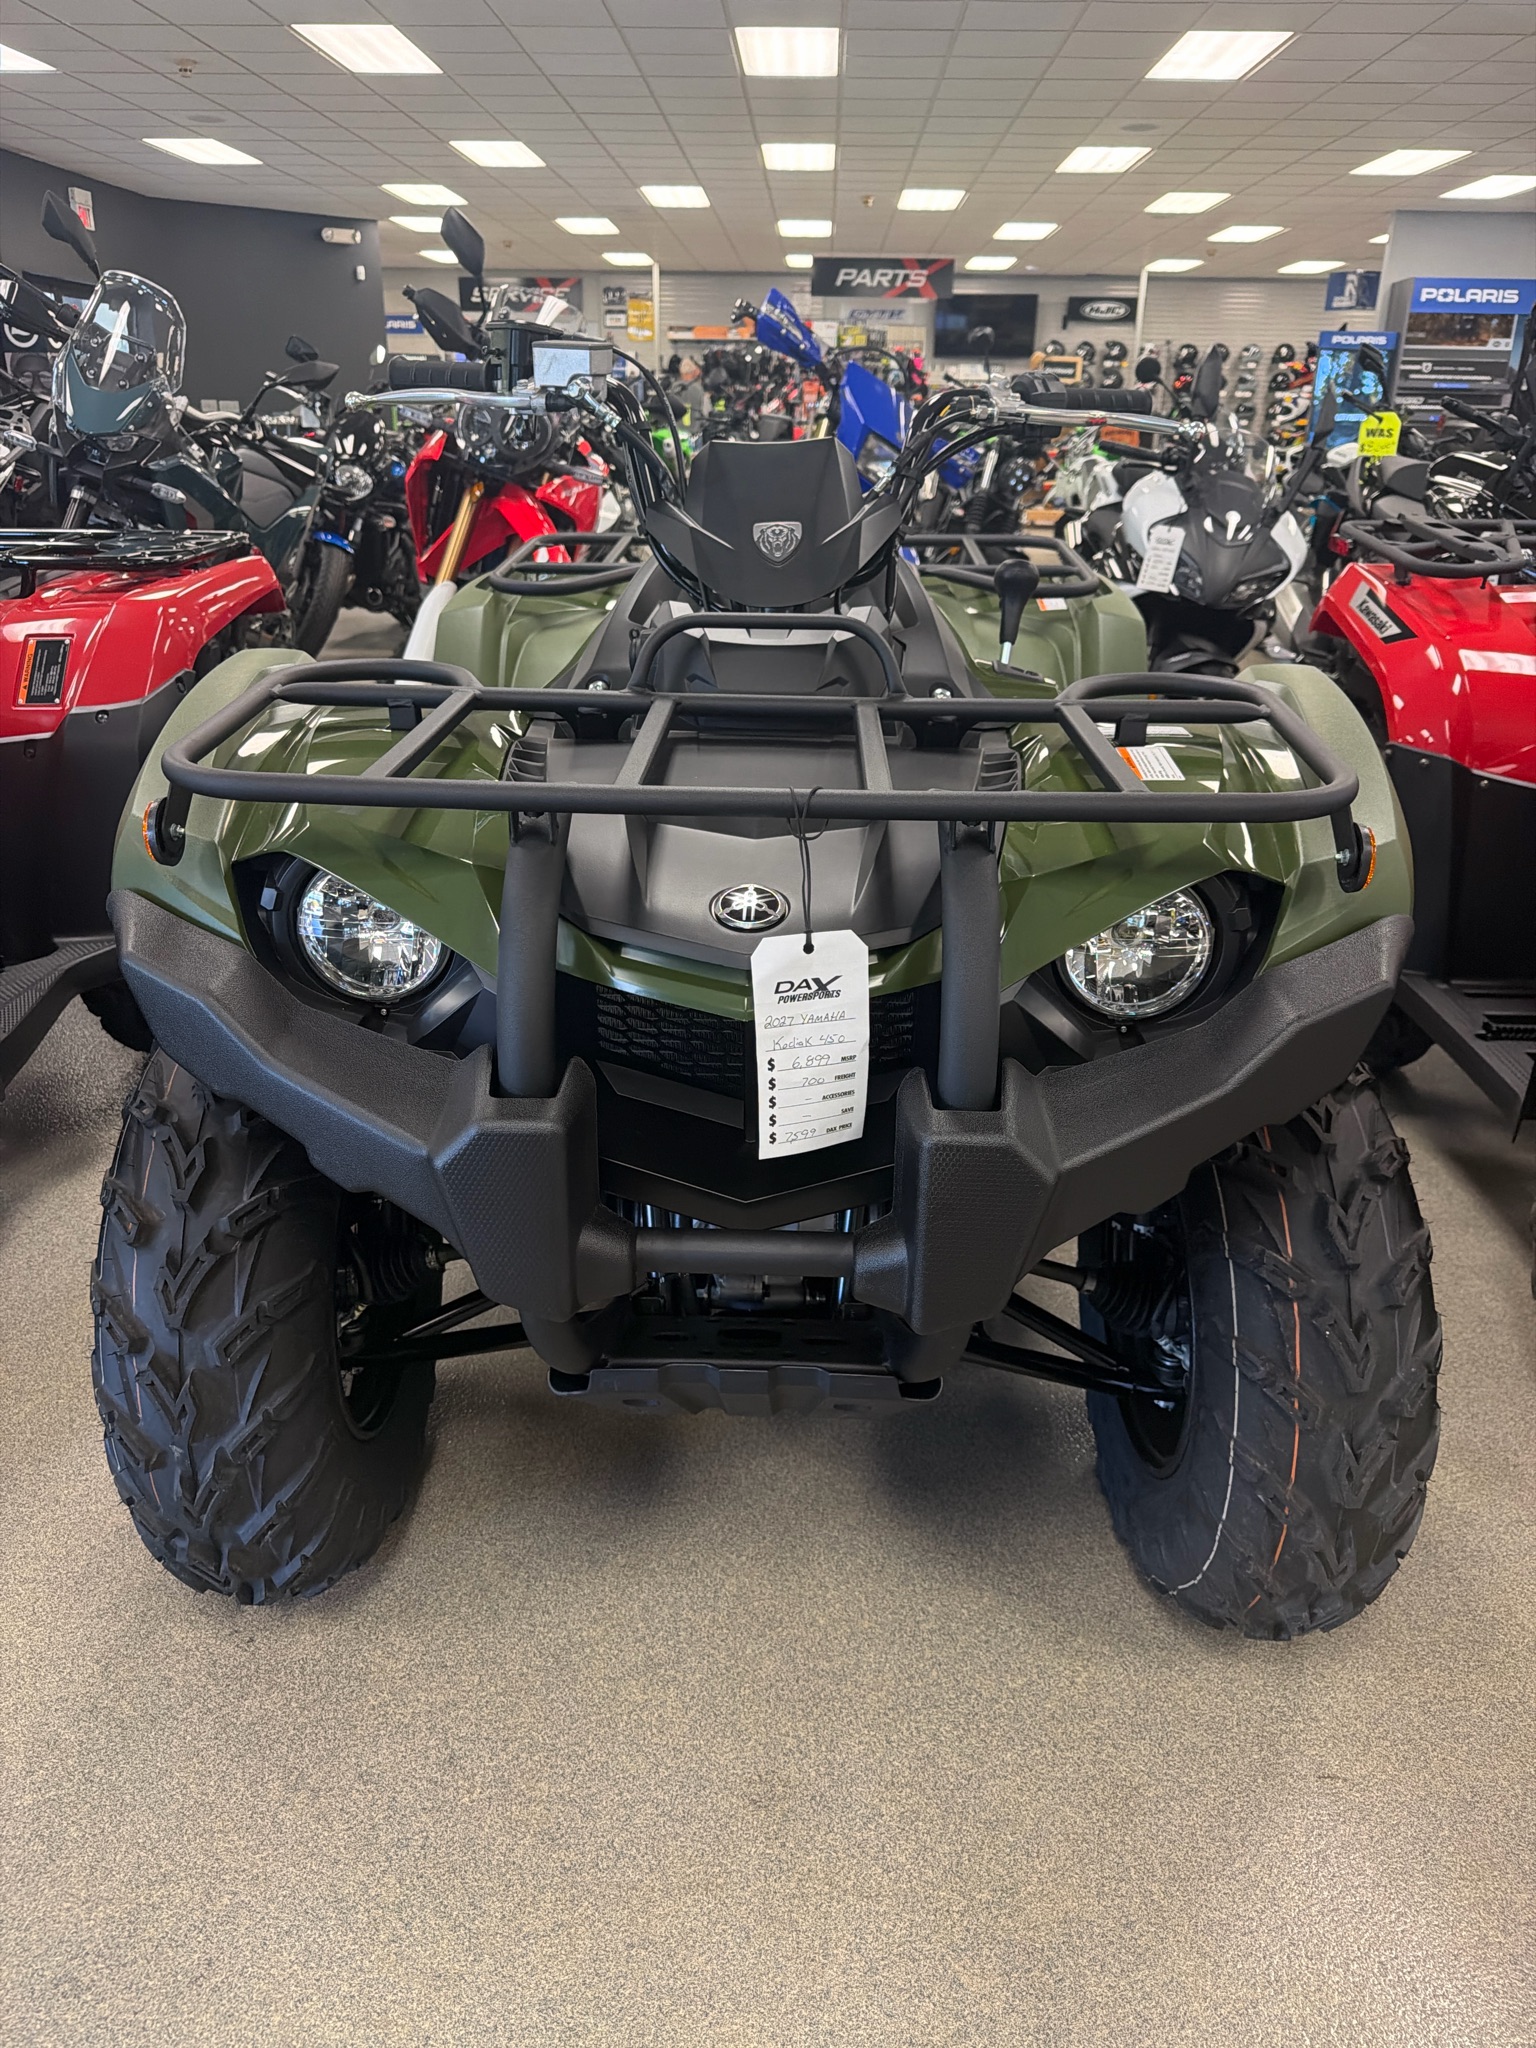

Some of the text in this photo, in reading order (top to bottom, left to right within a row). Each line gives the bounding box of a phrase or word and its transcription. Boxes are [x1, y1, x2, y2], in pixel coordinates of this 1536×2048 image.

[834, 268, 929, 288] PARTS
[1419, 287, 1520, 304] POLARIS
[1331, 335, 1388, 345] POLARIS
[1365, 427, 1394, 439] WAS
[1355, 598, 1393, 635] Kawasaki
[23, 653, 33, 683] WARNING
[773, 974, 844, 995] DAX
[777, 989, 842, 1005] POWERSPORTS
[764, 1010, 846, 1029] 2027 YAMAHA
[819, 1034, 846, 1046] 450
[767, 1053, 857, 1073] $ 6,899 MSRP
[768, 1072, 857, 1091] $ 700 FREIGHT
[768, 1089, 855, 1110] $ ACCESSORIES
[768, 1106, 855, 1128] $ SAVE
[768, 1131, 777, 1145] $
[838, 1122, 853, 1130] PRICE
